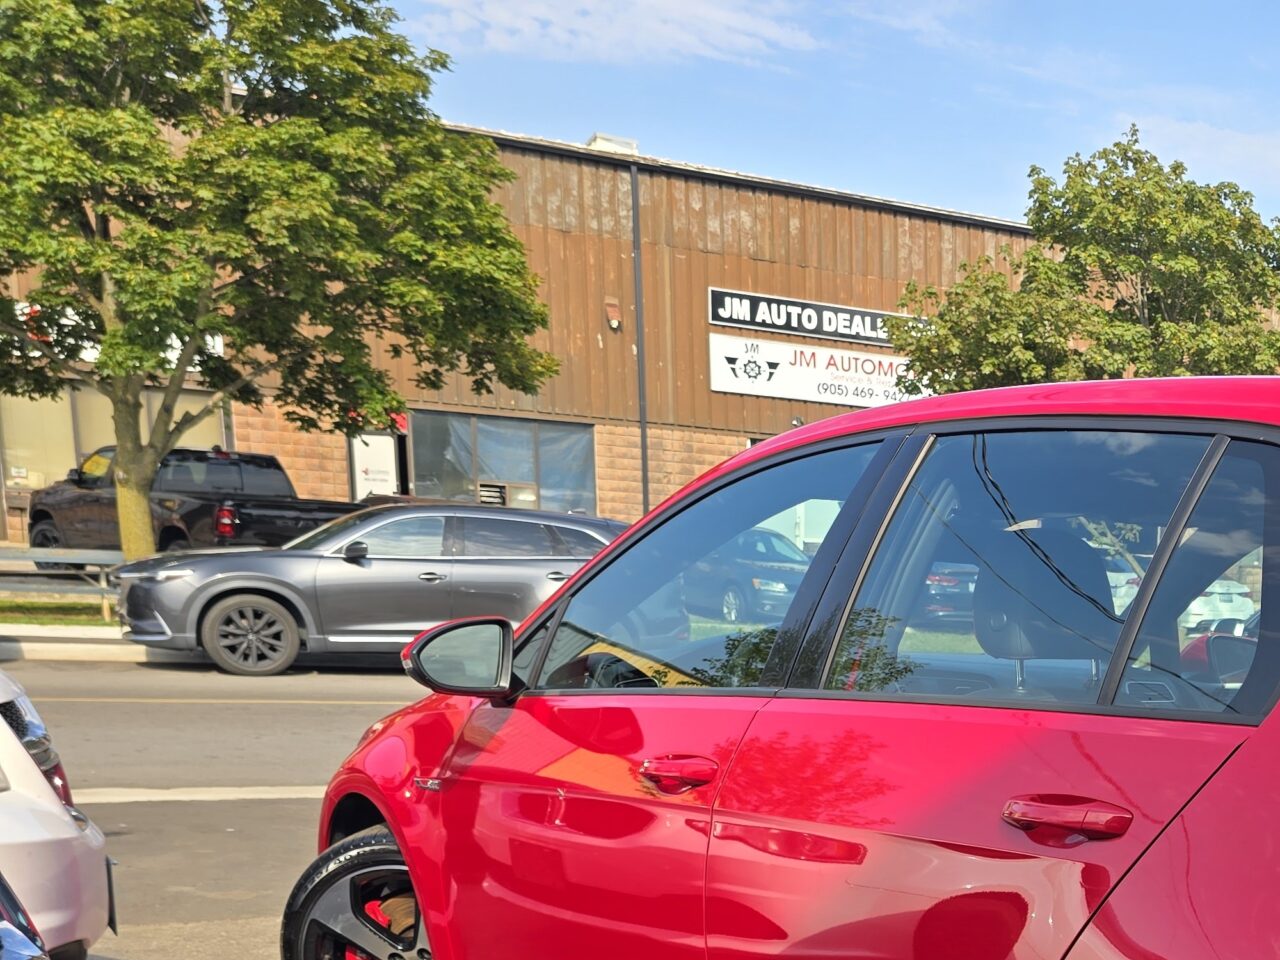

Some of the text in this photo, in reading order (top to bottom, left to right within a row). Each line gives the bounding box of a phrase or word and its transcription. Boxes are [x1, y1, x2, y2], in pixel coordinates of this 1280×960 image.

[718, 296, 889, 340] JM AUTO DEALE
[789, 349, 911, 379] JM AUTOMO
[817, 382, 849, 398] (905)
